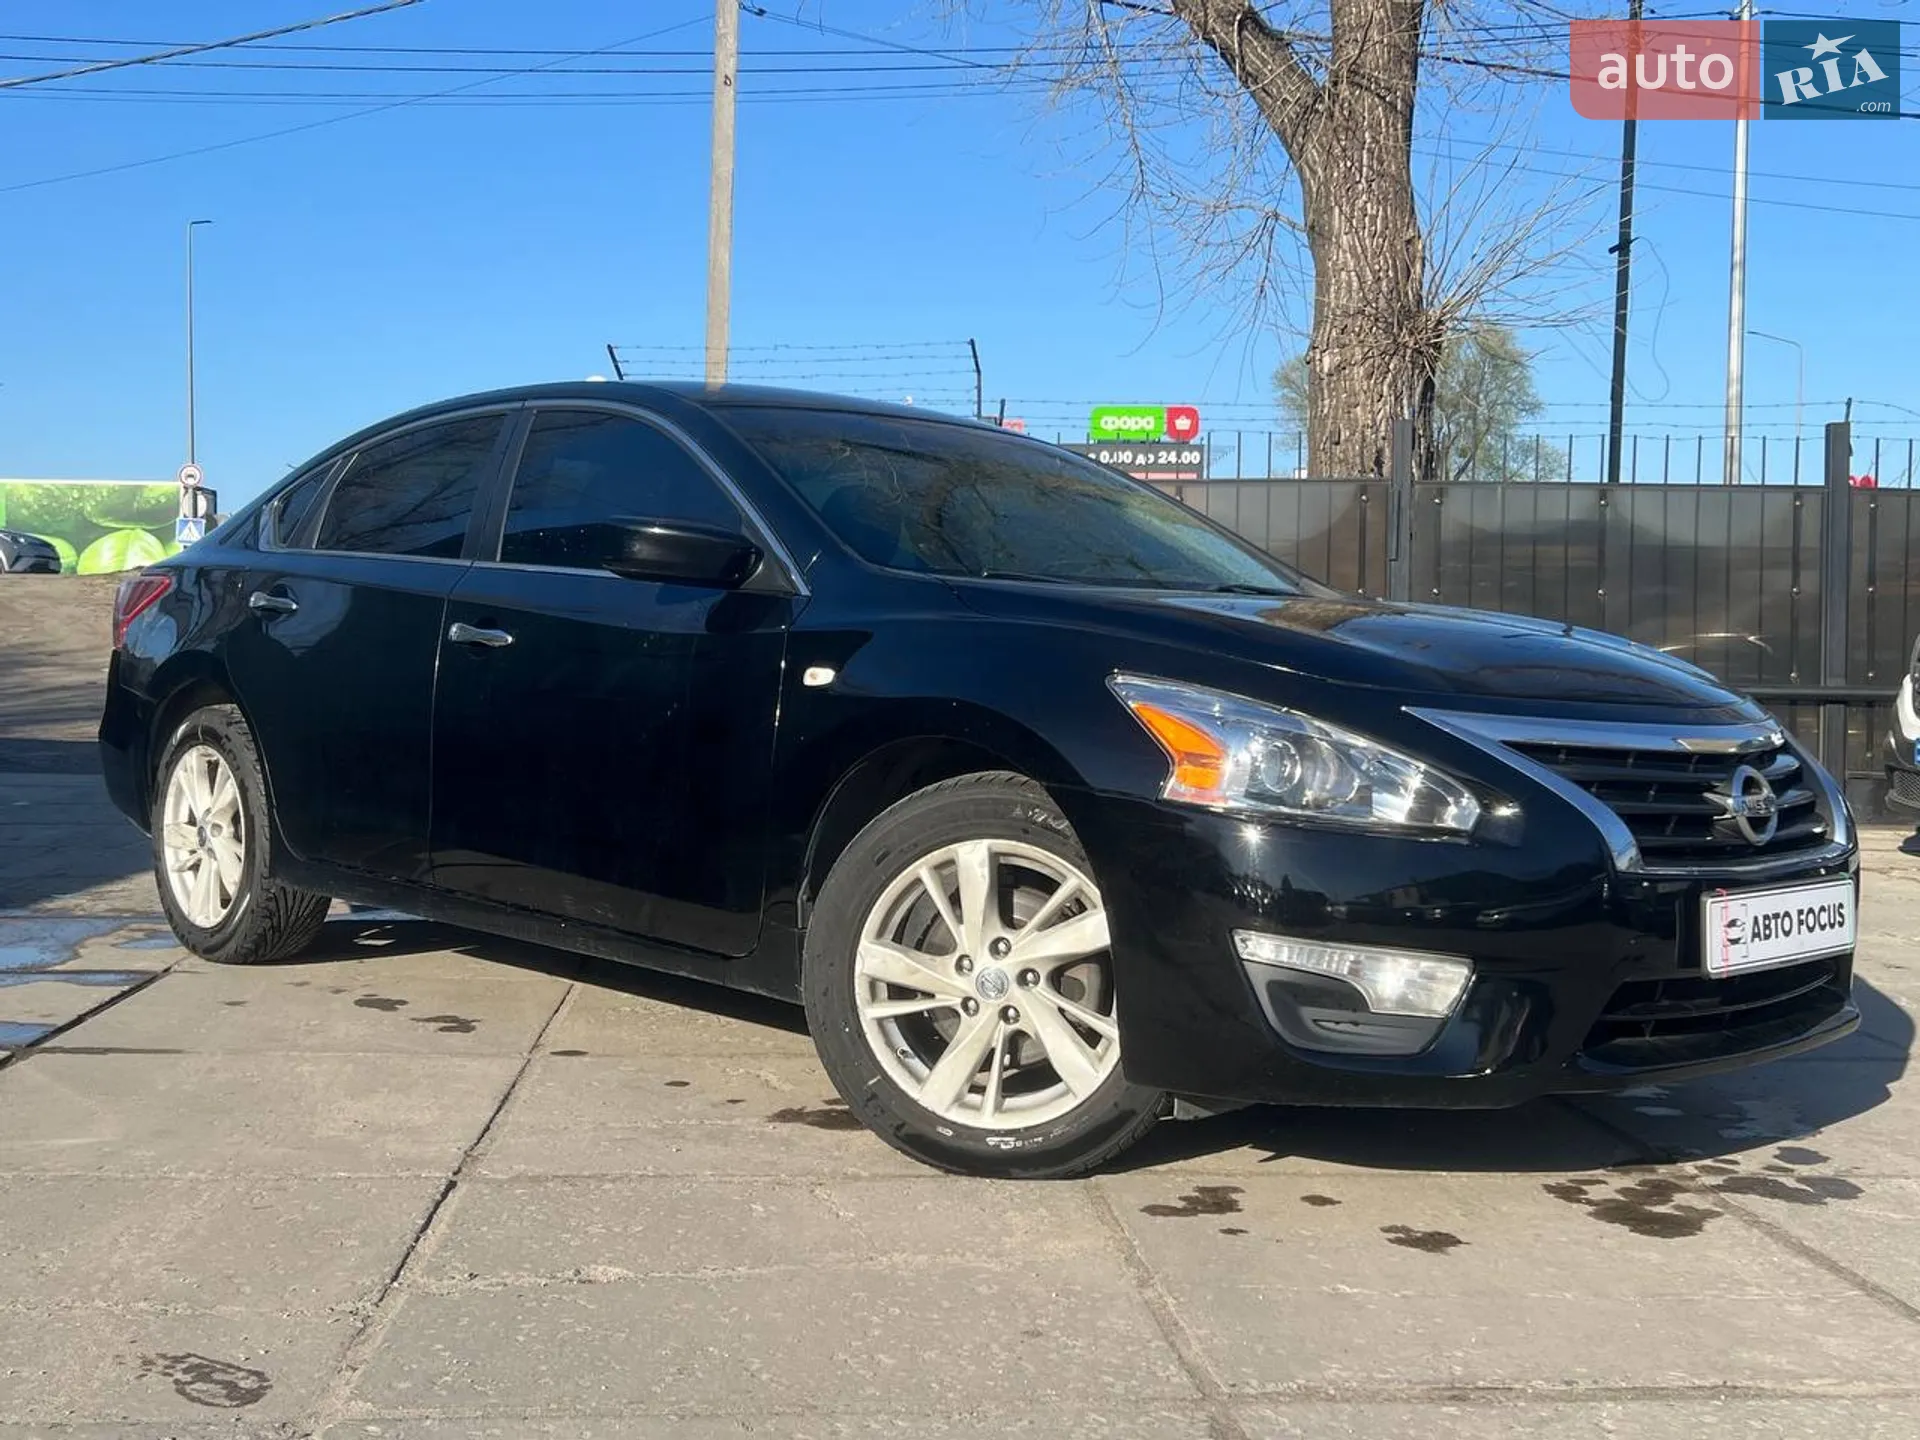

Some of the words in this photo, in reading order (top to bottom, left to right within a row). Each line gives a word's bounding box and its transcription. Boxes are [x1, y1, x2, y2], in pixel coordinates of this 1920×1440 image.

[1157, 451, 1200, 464] 24.00
[1751, 911, 1793, 942] АВТО
[1797, 902, 1845, 934] FOCUS
